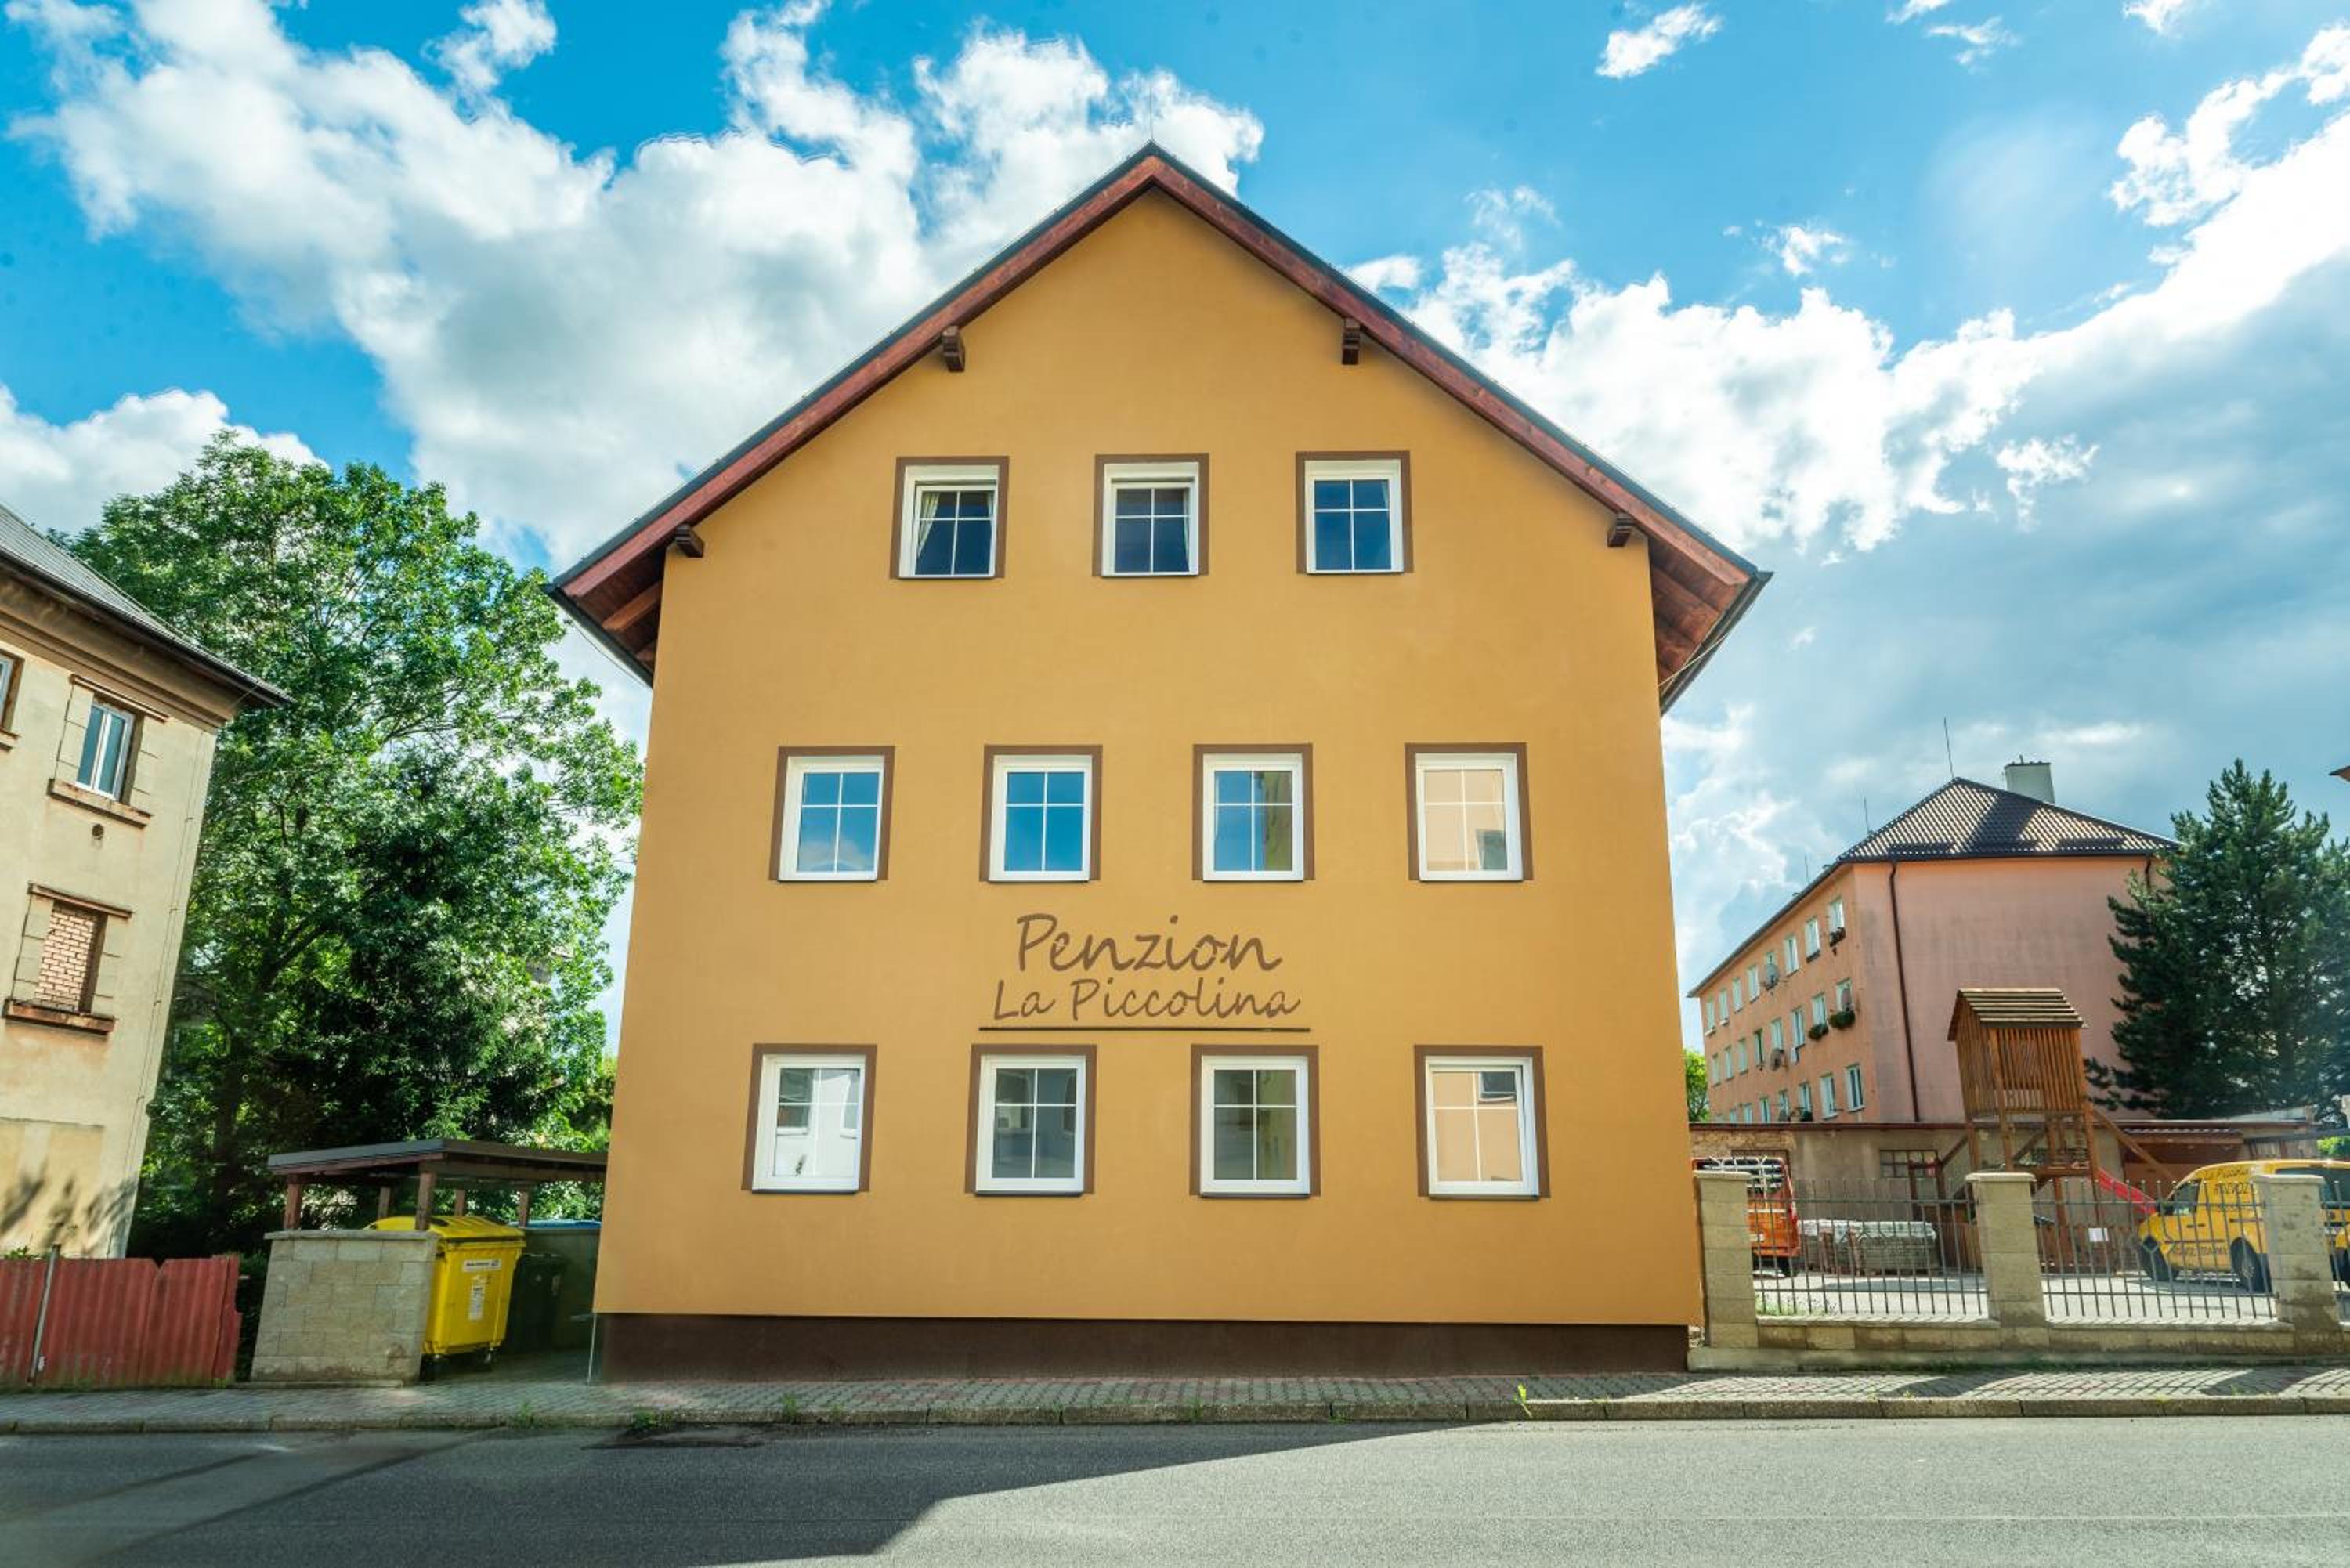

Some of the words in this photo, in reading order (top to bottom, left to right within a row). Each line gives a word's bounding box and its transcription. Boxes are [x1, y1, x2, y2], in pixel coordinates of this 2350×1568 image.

[1016, 912, 1282, 972] Penzion
[993, 979, 1055, 1021] La
[1070, 977, 1301, 1021] Piccolina
